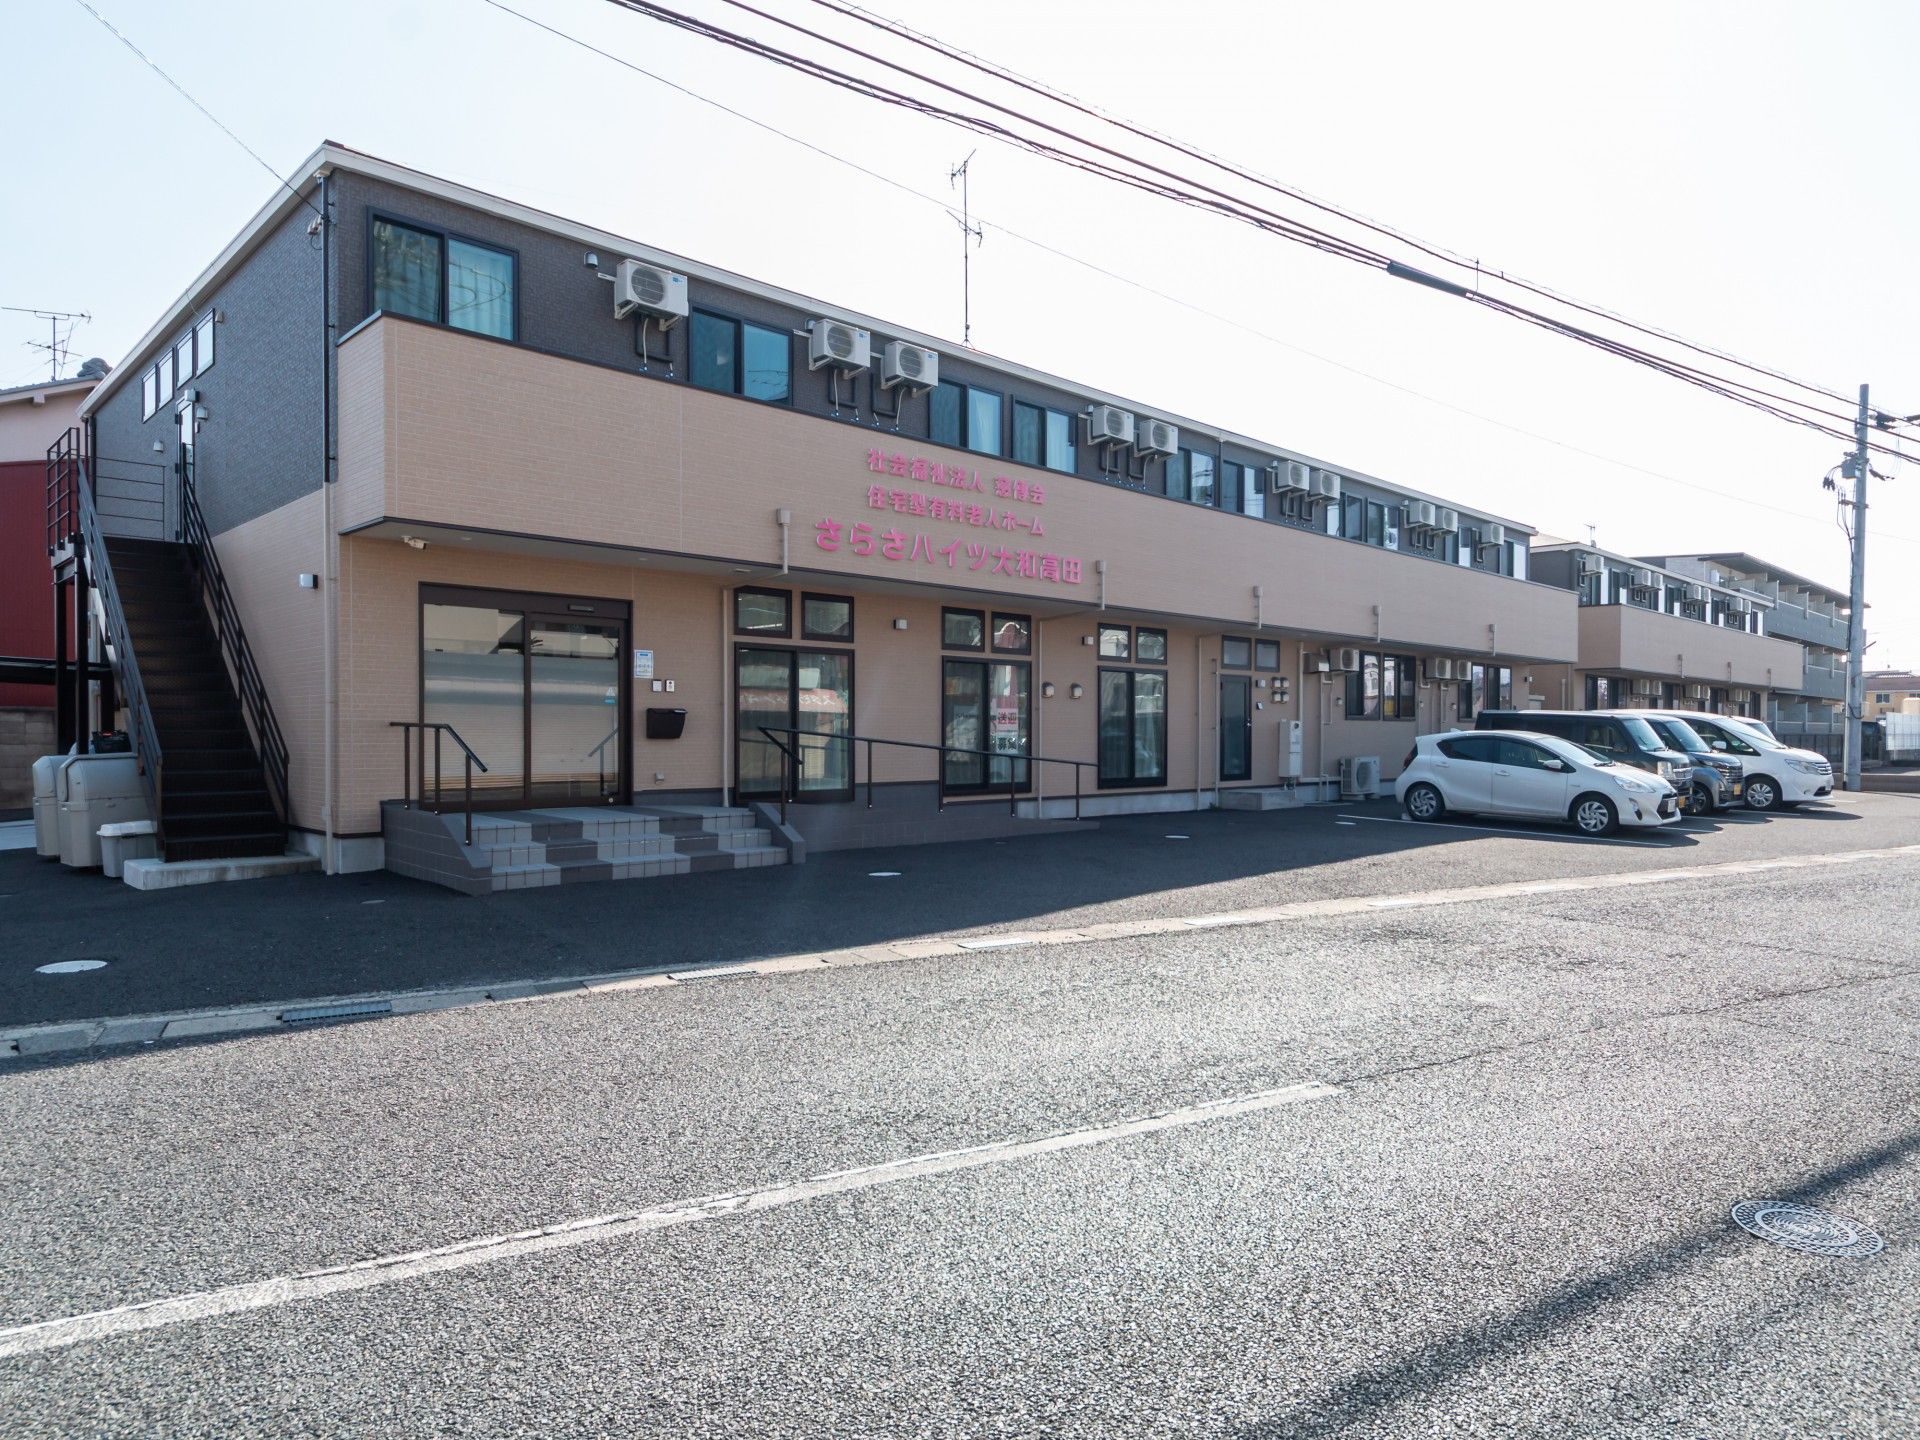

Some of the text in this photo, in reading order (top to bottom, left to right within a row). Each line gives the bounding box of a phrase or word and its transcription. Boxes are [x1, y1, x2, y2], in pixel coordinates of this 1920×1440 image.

[867, 448, 985, 493] 社会福祉法人
[867, 485, 1046, 537] 住宅型有料老人ホーム
[814, 516, 1083, 584] さらさハイツ大和高田
